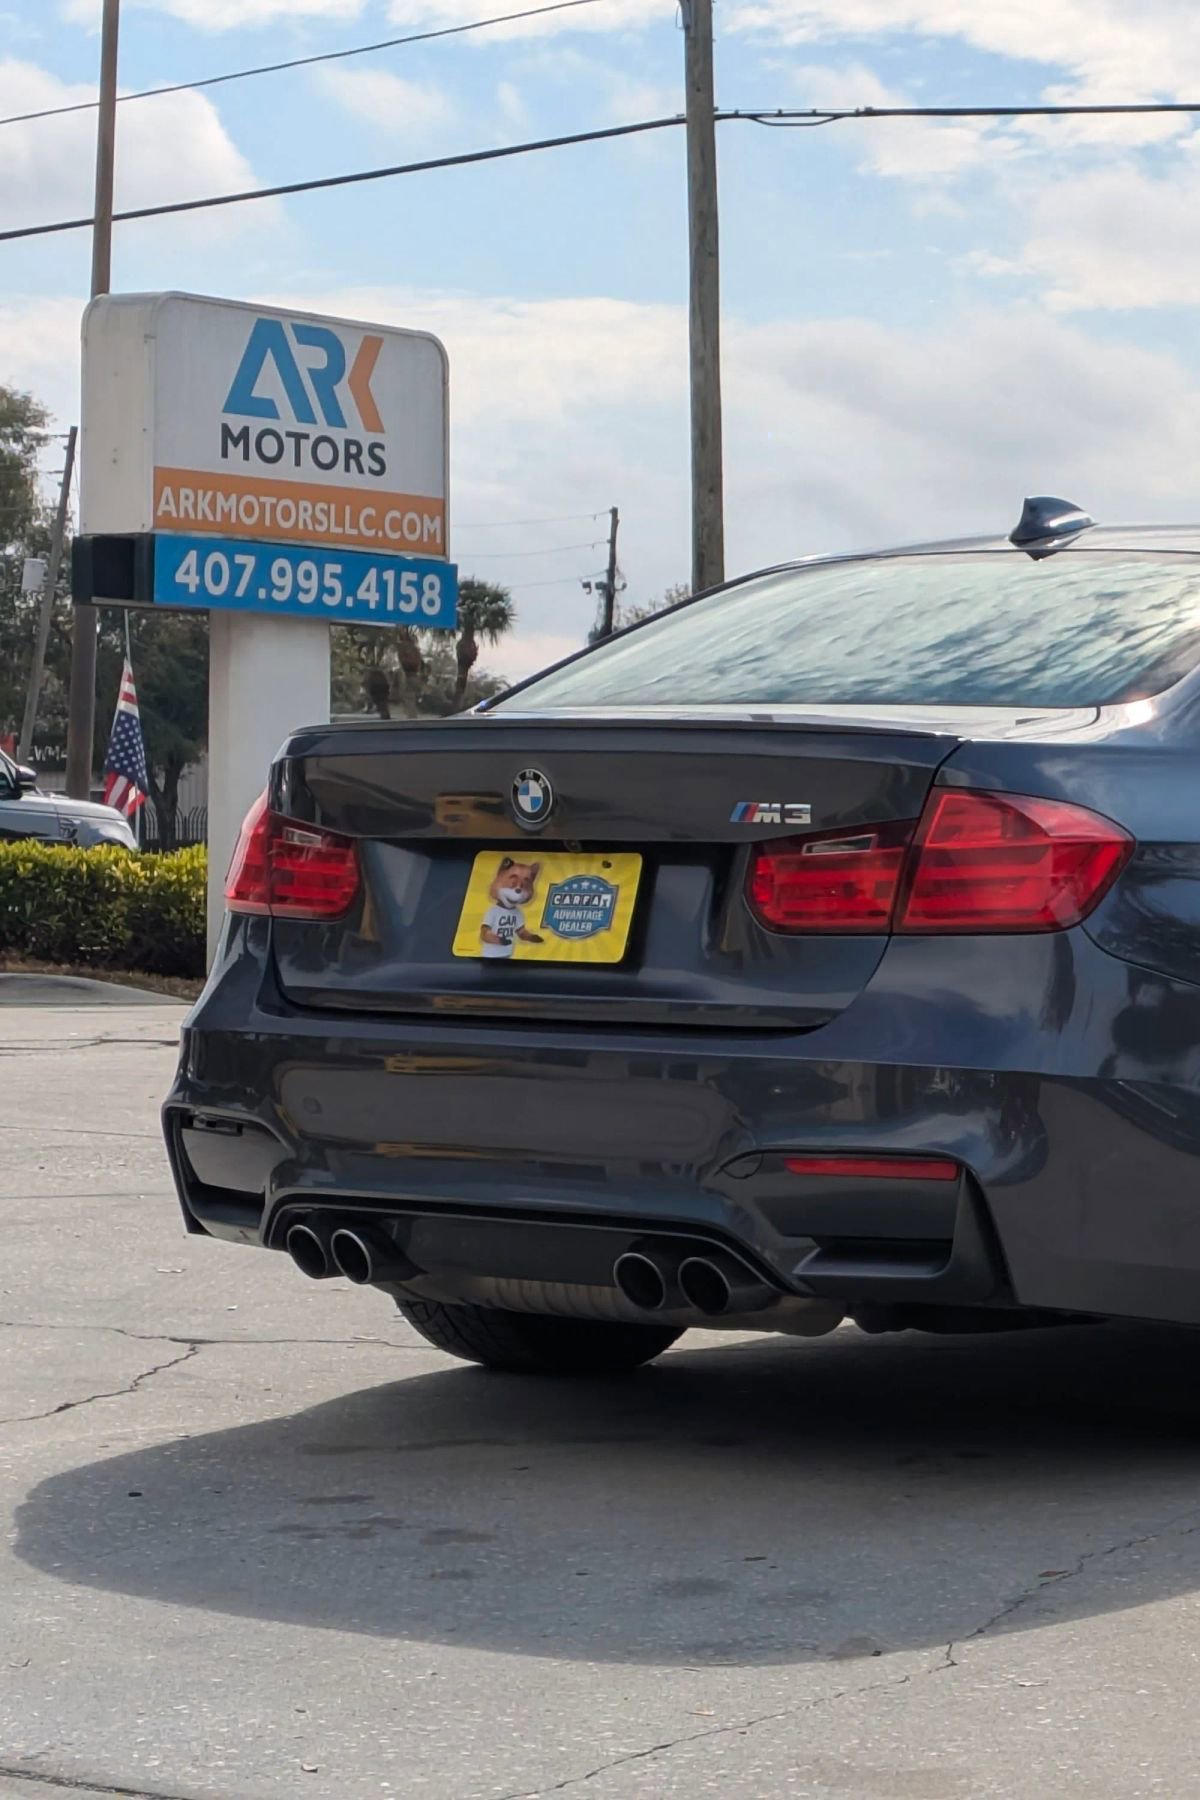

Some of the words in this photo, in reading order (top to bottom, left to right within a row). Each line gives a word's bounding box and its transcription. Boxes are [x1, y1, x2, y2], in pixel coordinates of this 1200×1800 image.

[222, 317, 385, 434] ARK
[220, 422, 387, 477] MOTORS
[157, 486, 441, 544] ARKMOTORSLLC.COM
[174, 550, 441, 615] 407.995.4158
[752, 802, 811, 824] M3
[498, 915, 517, 926] CAR
[553, 910, 603, 921] ADVANTAGE
[558, 921, 592, 932] DEALER
